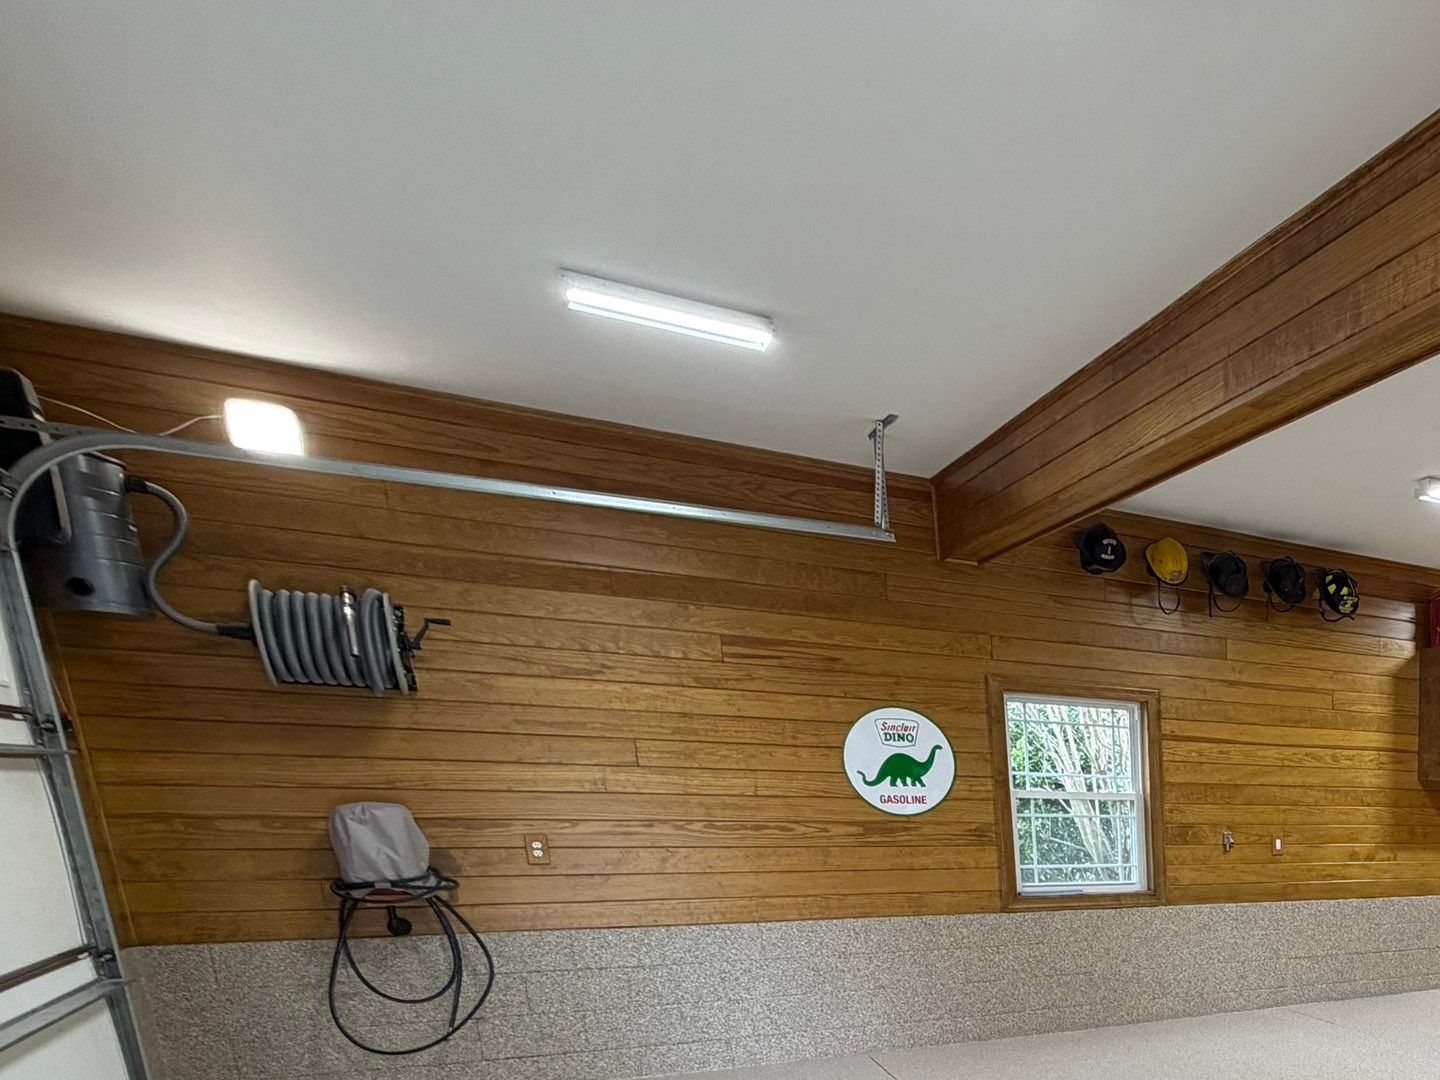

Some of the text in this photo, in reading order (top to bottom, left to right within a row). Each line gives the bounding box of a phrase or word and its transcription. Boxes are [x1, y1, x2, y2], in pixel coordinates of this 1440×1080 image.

[881, 721, 916, 732] Sinclair
[883, 732, 914, 743] DINO
[879, 794, 928, 805] GASOLINE
